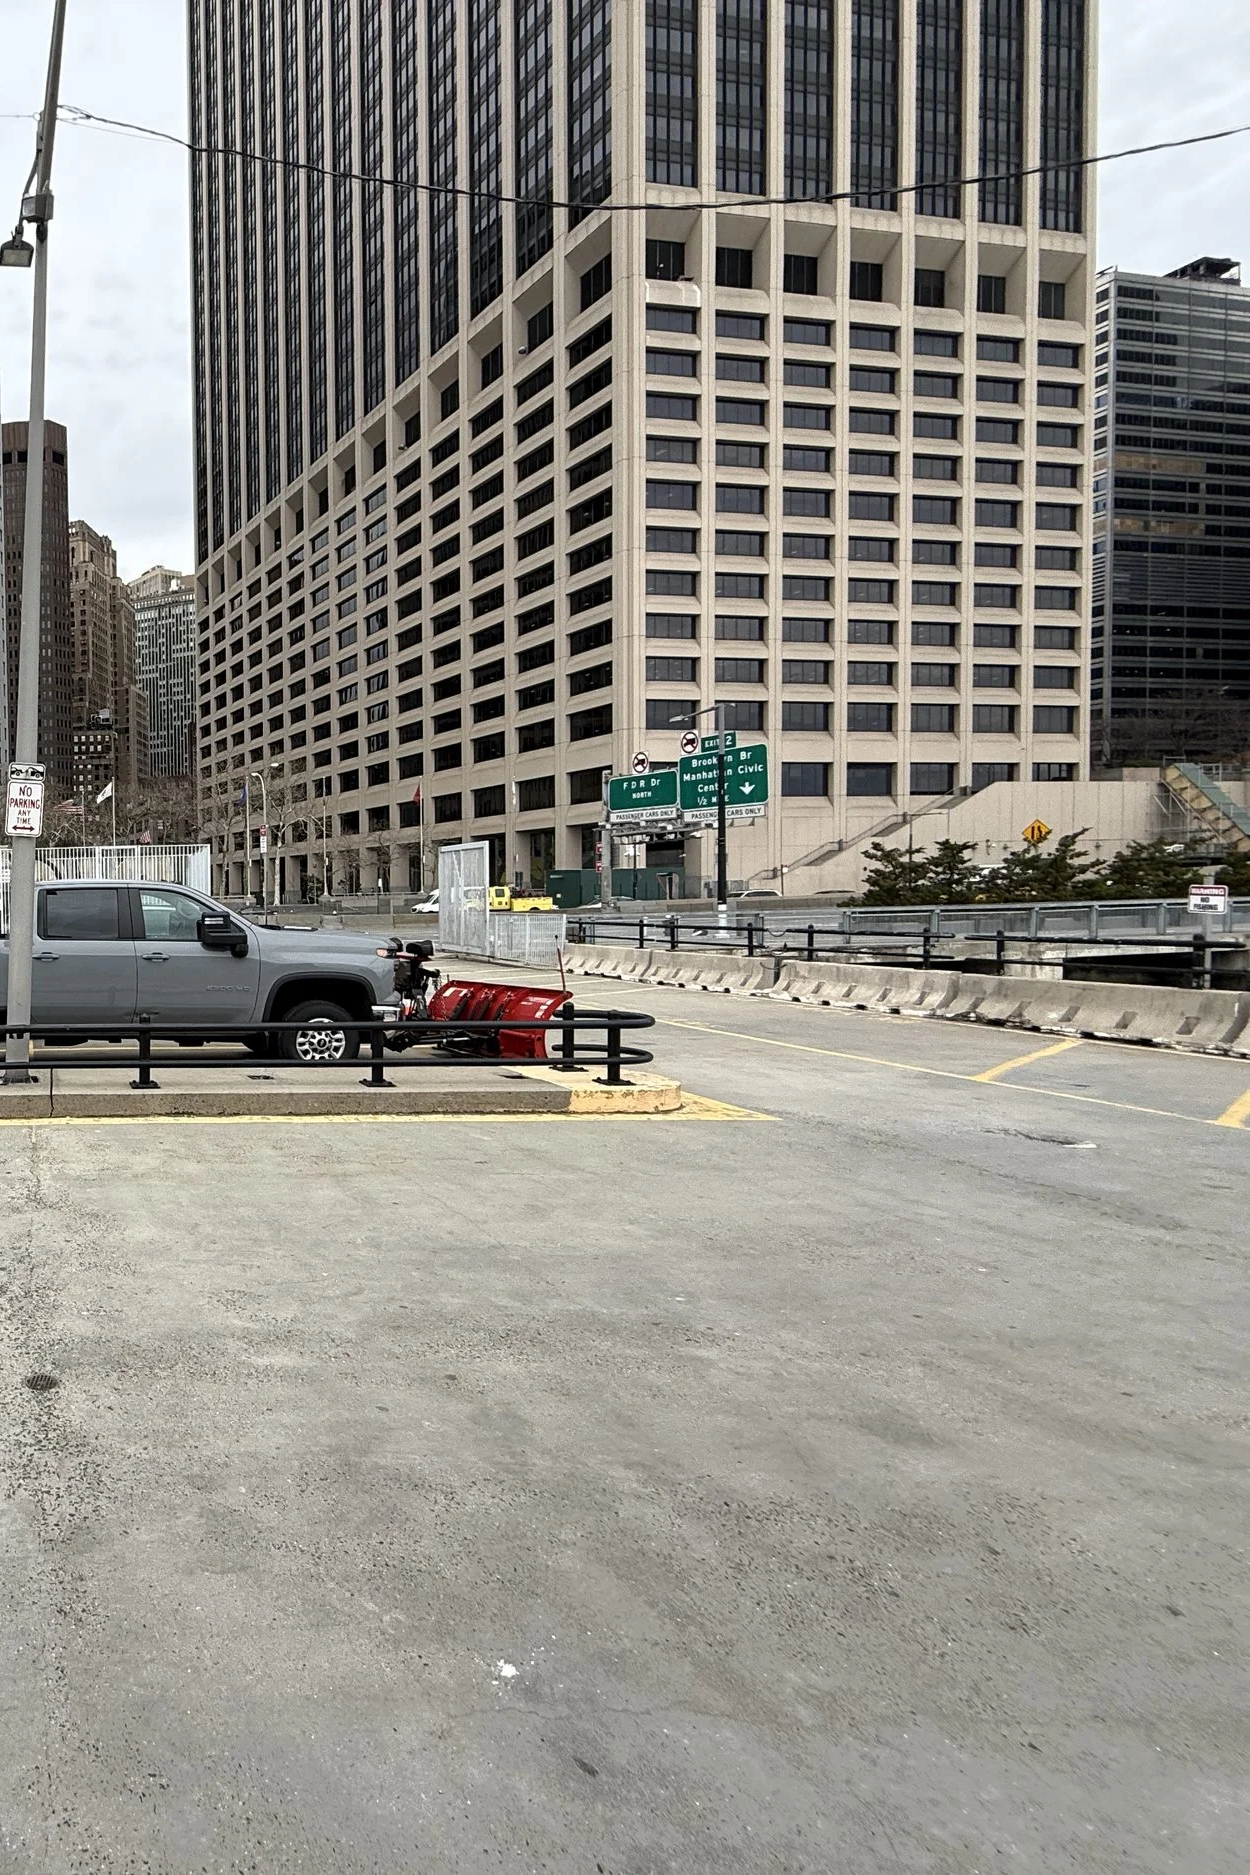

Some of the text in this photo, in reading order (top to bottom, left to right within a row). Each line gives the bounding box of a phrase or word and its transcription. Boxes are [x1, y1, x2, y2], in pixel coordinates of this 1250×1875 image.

[725, 735, 733, 745] 2
[691, 751, 752, 768] Brookn Br
[683, 763, 764, 782] Manhatn Civic
[623, 778, 661, 790] F D R Dr
[697, 782, 729, 793] Centr
[18, 785, 33, 796] NO
[632, 791, 652, 799] NORTH
[9, 797, 41, 810] PARKING
[711, 795, 729, 803] ME
[616, 812, 644, 820] PASSENGER
[660, 809, 674, 817] ONLY
[691, 807, 762, 820] PASSENG CARS ONLY
[17, 817, 31, 825] TIME
